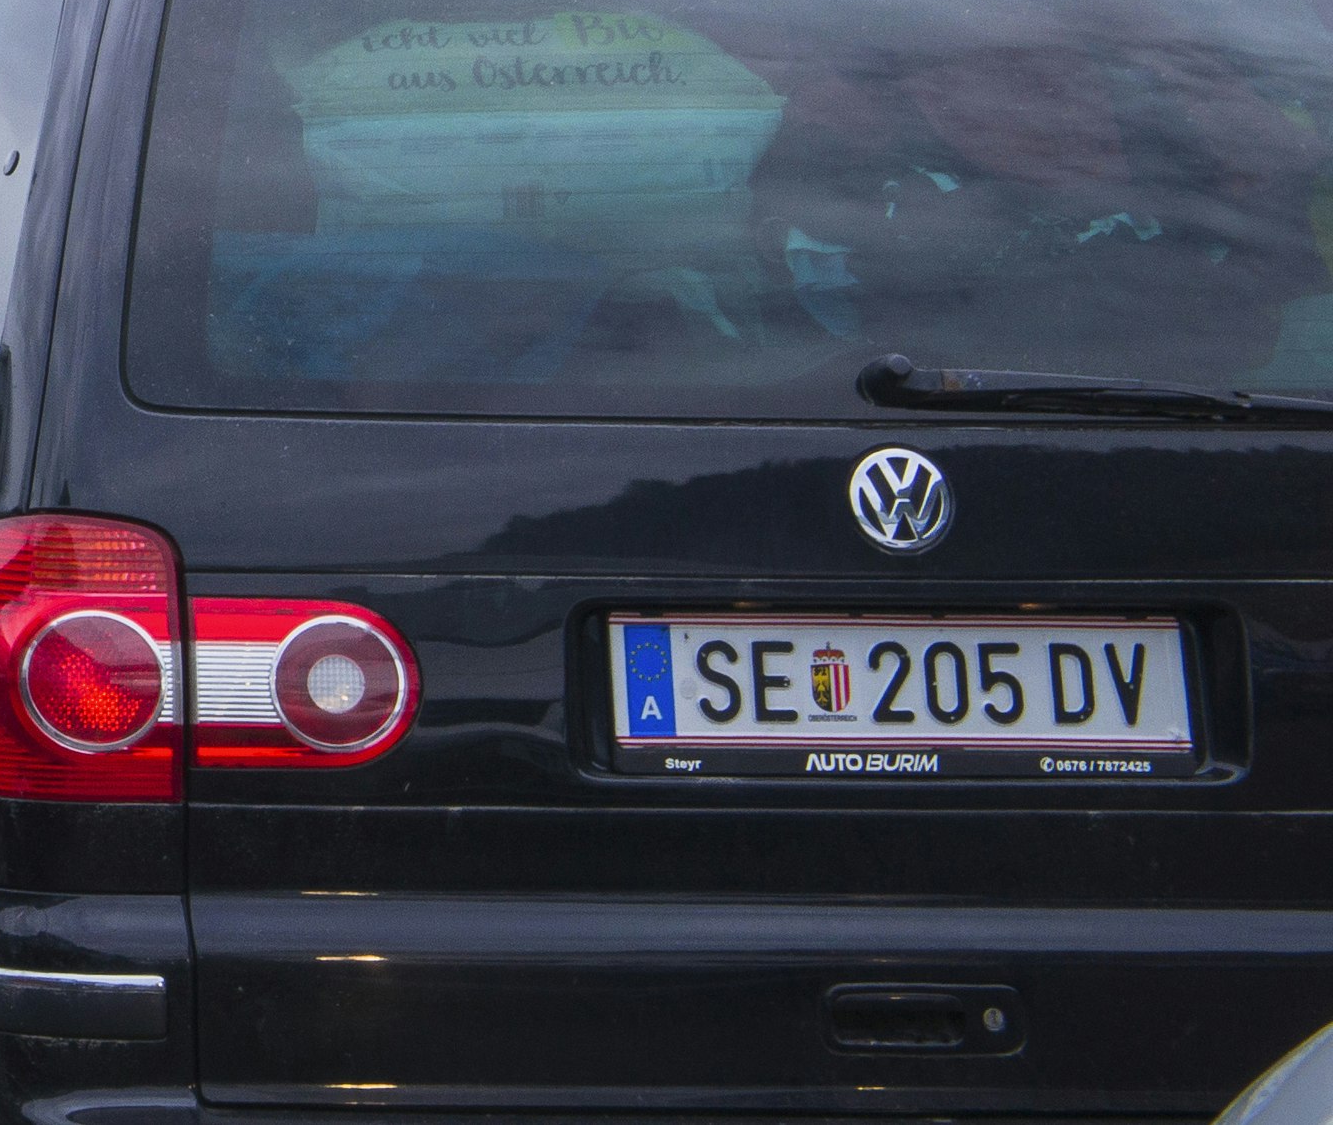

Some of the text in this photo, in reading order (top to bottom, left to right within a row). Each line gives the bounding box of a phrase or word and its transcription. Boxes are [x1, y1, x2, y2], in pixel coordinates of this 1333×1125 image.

[388, 70, 457, 92] aus
[696, 639, 1145, 726] SE 205 DV
[640, 695, 663, 720] A
[664, 757, 702, 771] Steyr
[805, 753, 938, 772] AUTO BURIM
[1056, 760, 1087, 772] 0676
